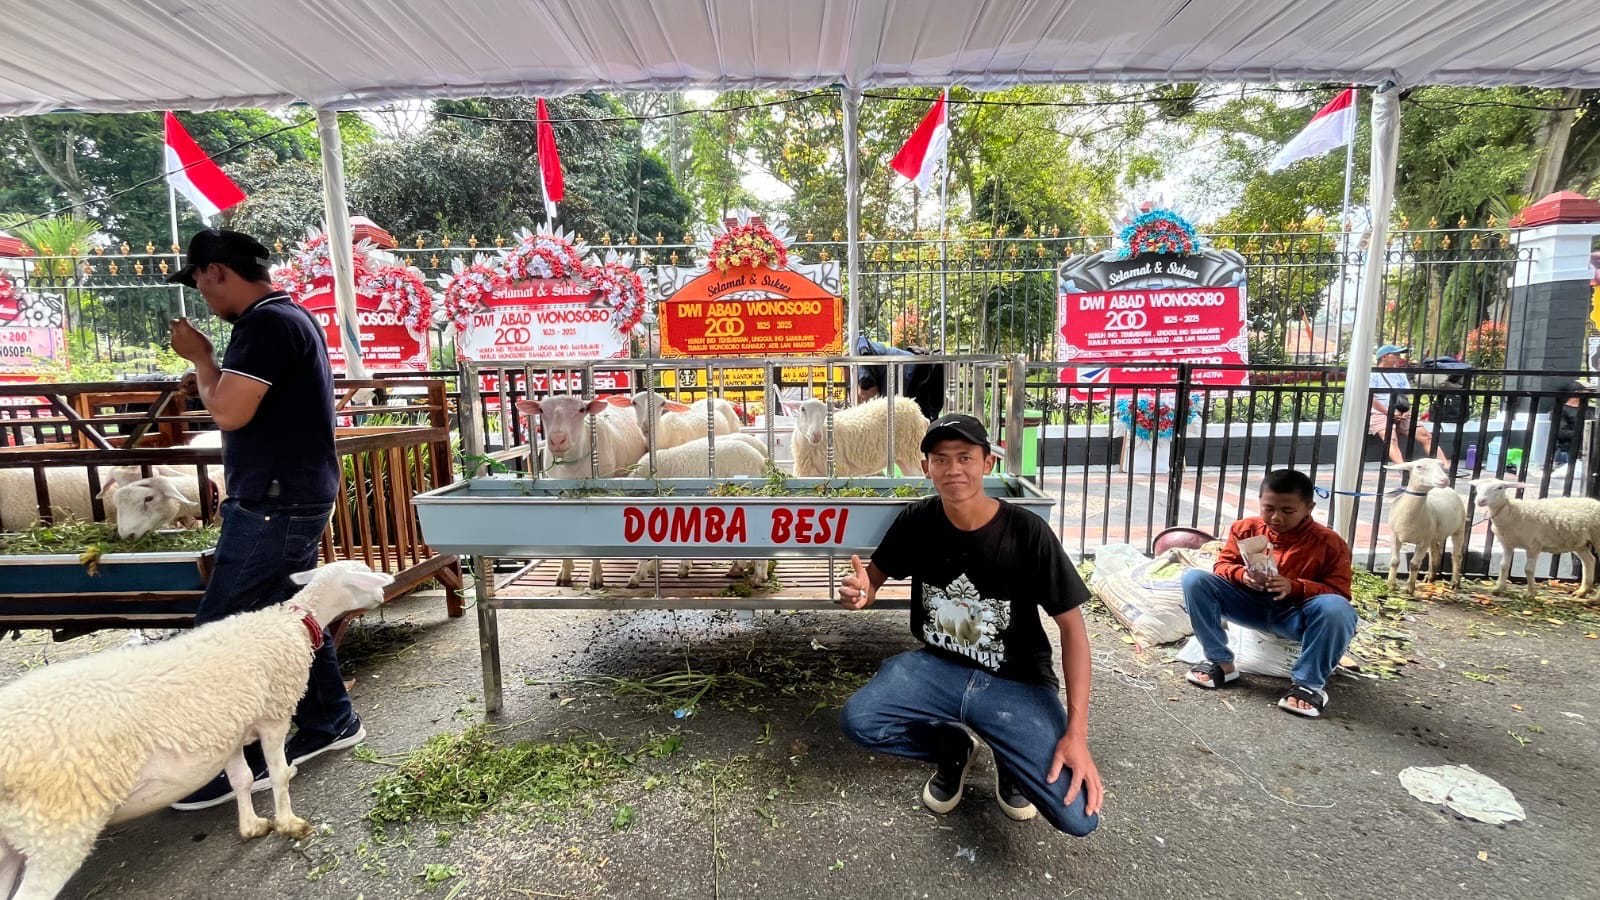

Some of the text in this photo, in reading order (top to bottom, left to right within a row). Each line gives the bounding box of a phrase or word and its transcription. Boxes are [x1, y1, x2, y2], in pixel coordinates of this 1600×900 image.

[1109, 261, 1199, 286] Selamat & Sukses
[492, 284, 591, 300] Selamat & Sukses
[708, 274, 792, 297] Selamat & Sukses
[678, 299, 822, 318] DWI ABAD WONOSOBO
[1079, 291, 1225, 311] DWI ABAD WONOSOBO
[474, 309, 610, 328] DWI ABAD WONOSOBO
[704, 317, 745, 337] 200
[1104, 309, 1147, 331] 200
[9, 331, 27, 342] 200
[494, 327, 531, 345] 200
[623, 506, 849, 545] DOMBA BESI
